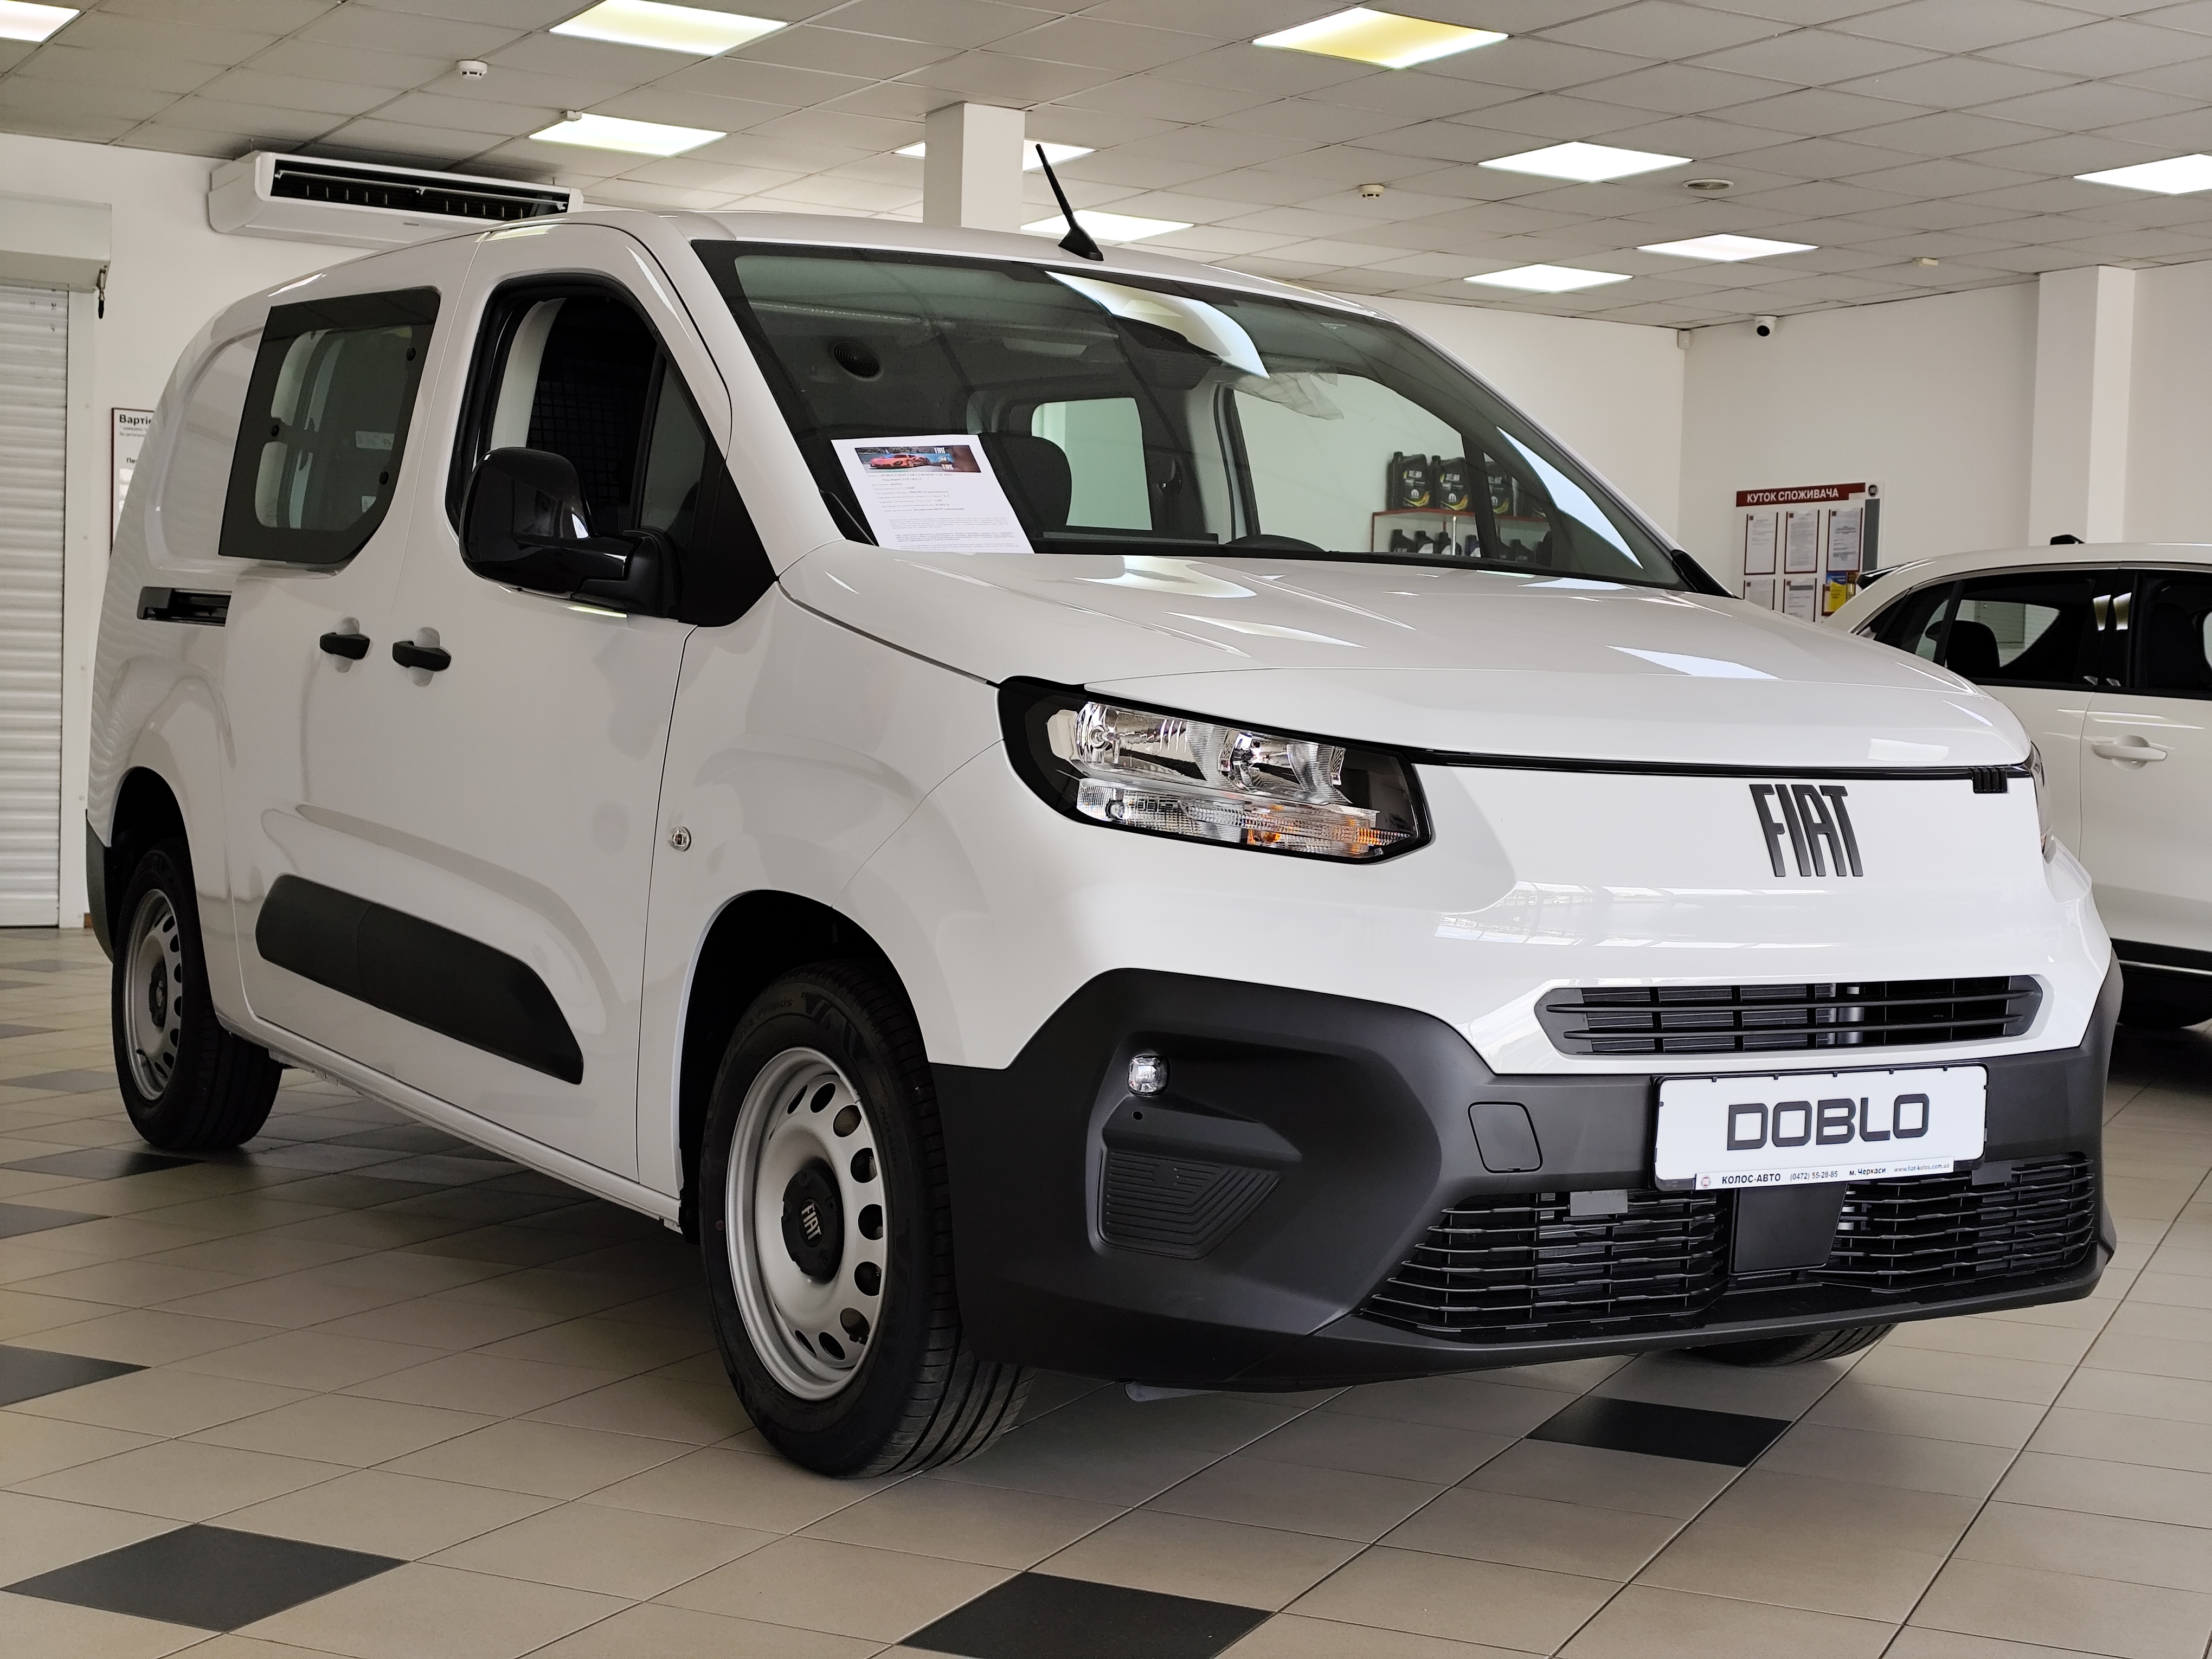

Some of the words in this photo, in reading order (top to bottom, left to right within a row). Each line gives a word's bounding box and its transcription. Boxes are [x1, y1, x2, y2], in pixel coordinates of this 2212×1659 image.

[1747, 492, 1776, 503] КУТОК
[1778, 488, 1839, 501] СПОЖИВАЧА
[1749, 784, 1863, 877] FIAT
[1727, 1093, 1930, 1150] DOBLO
[1722, 1173, 1781, 1184] КОЛОС-АВТО
[1790, 1172, 1810, 1182] (0472)
[1812, 1171, 1838, 1179] 55-28-85
[1857, 1167, 1886, 1175] Черкаси
[1894, 1163, 1950, 1173] www.fiat-kolos.com.ua
[801, 1203, 821, 1240] FIAT
